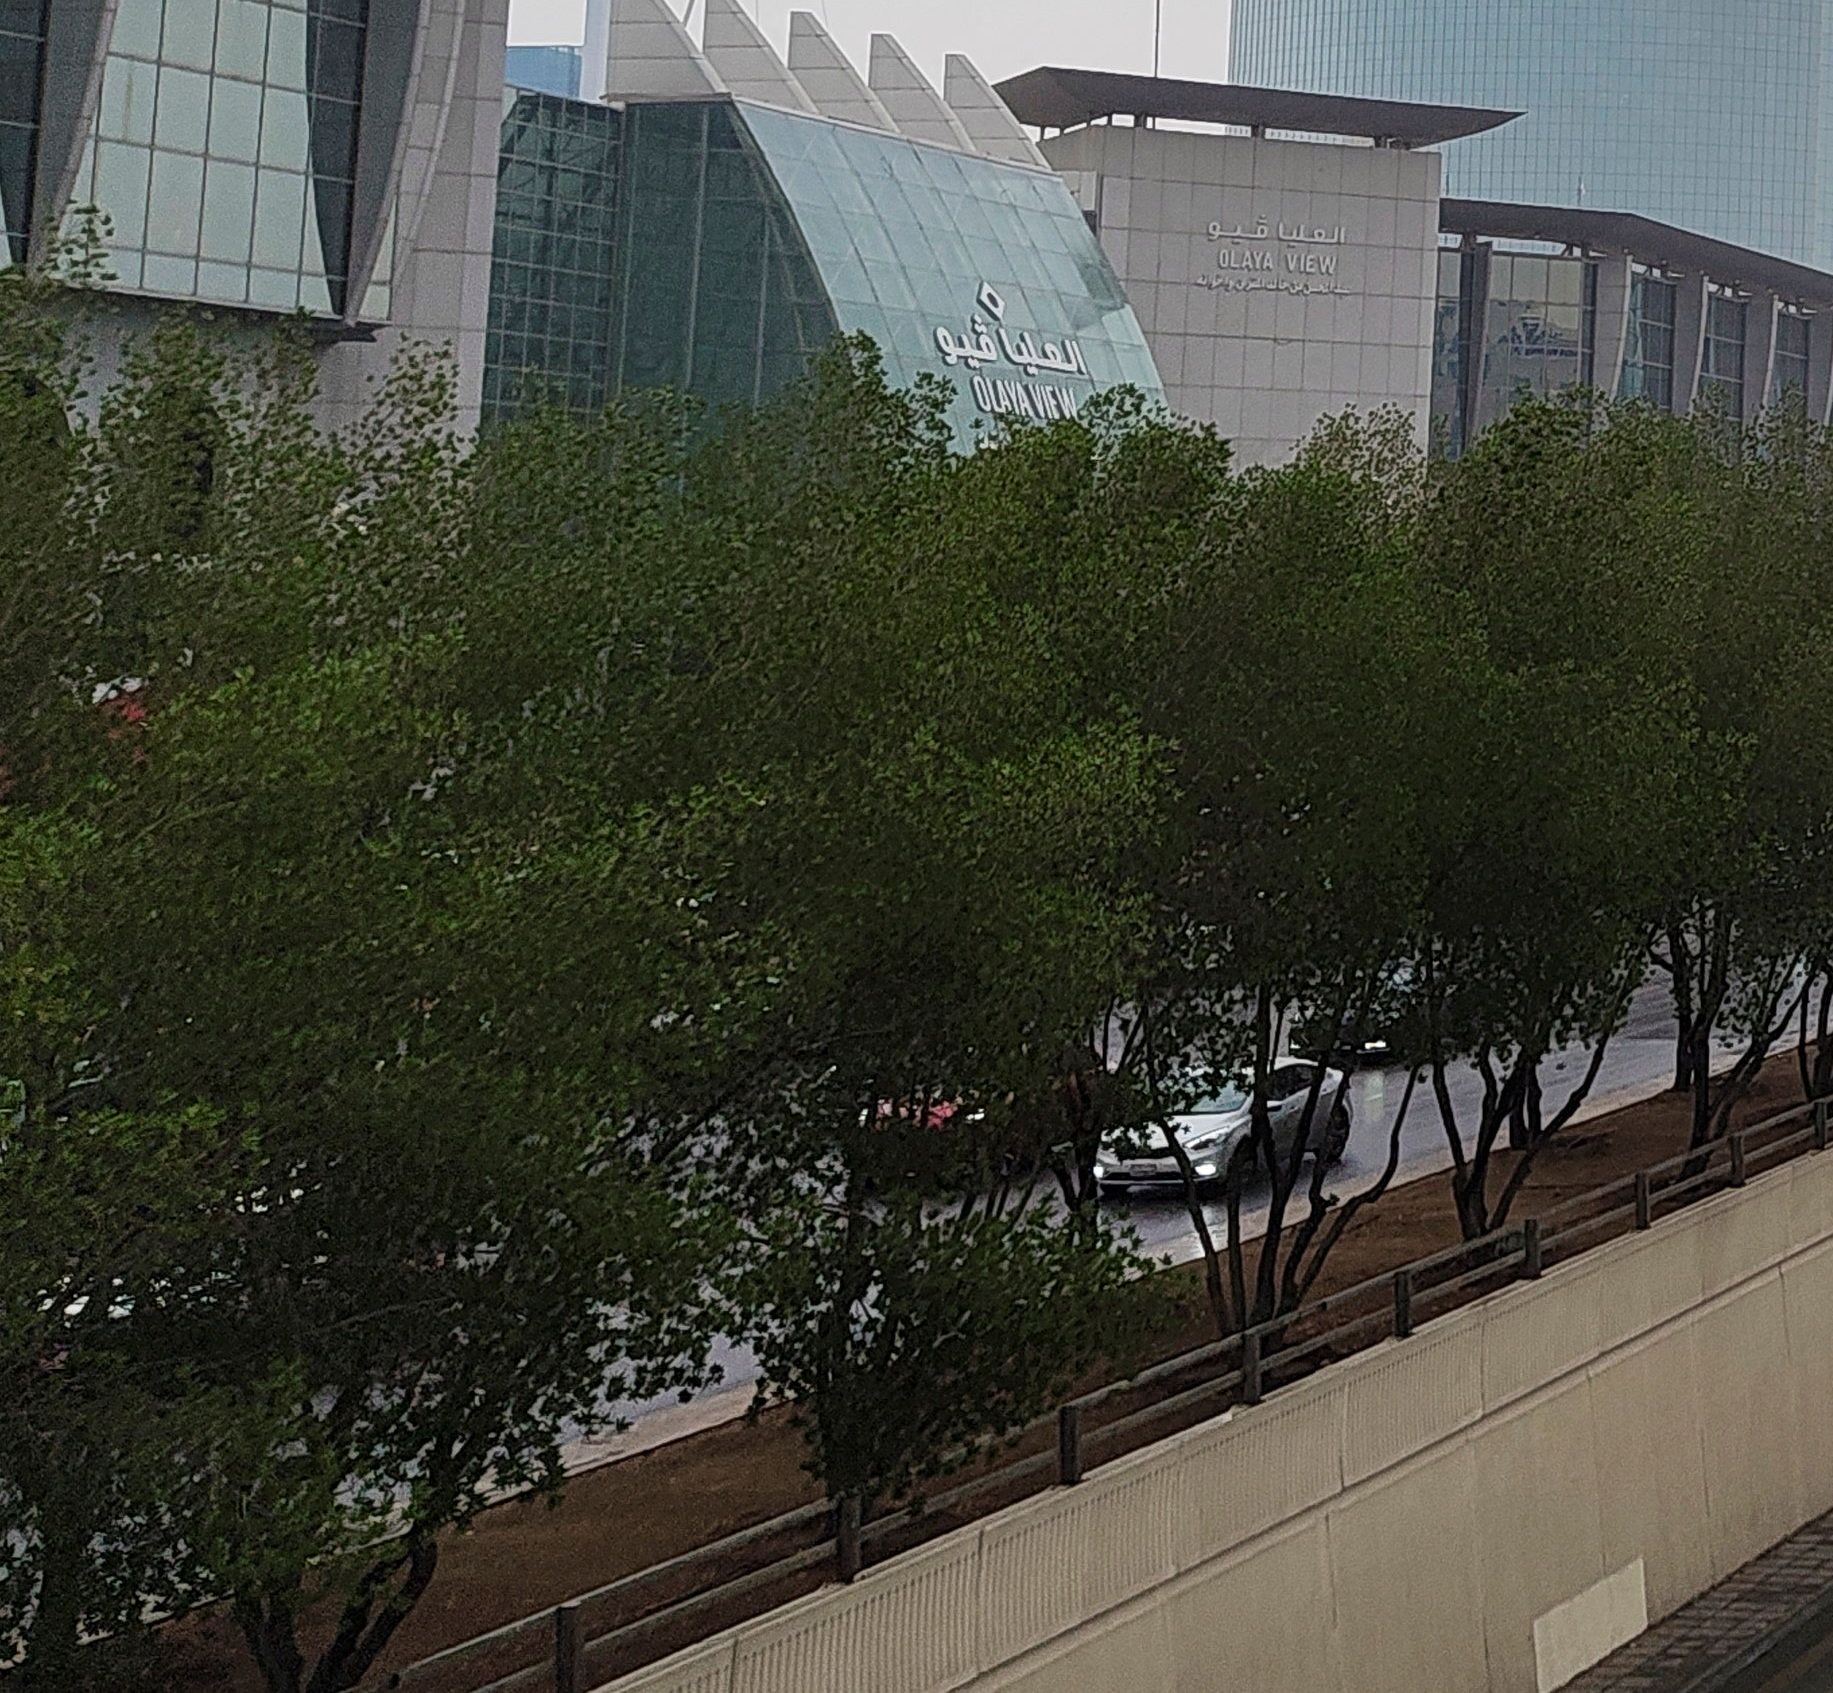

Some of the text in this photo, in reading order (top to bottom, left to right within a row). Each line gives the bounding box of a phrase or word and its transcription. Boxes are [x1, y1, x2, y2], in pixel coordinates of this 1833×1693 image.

[1278, 222, 1346, 249] العليا
[1219, 249, 1337, 275] OLAYA VIEW
[998, 327, 1087, 376] العليا
[972, 374, 1078, 421] OLAYA VIEW
